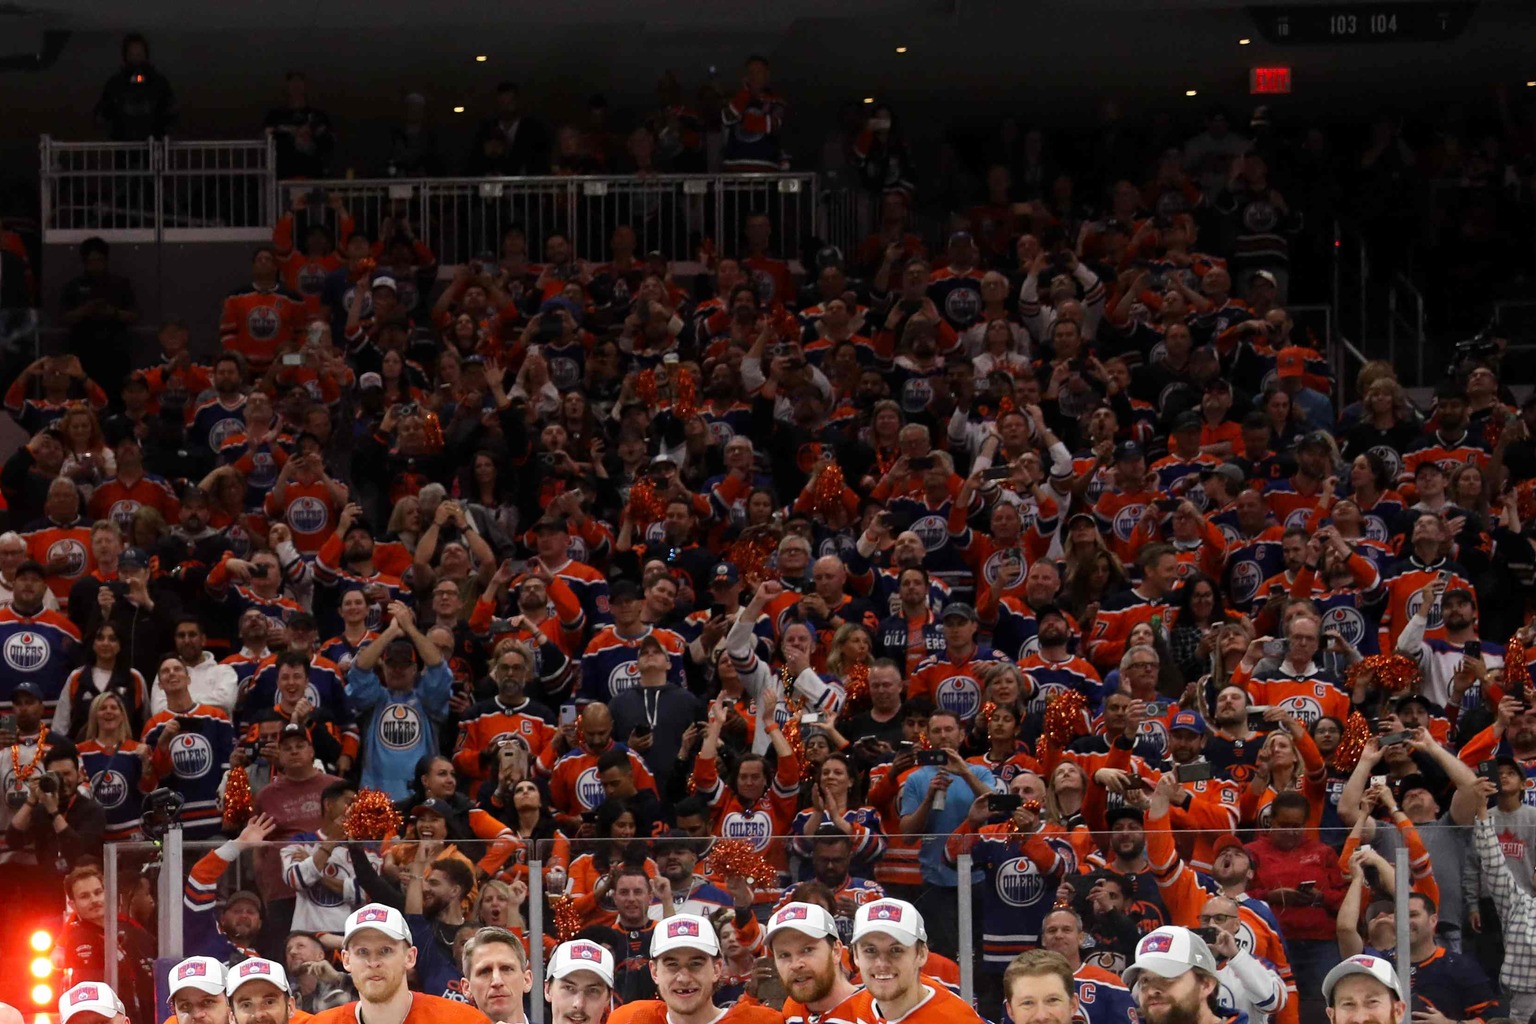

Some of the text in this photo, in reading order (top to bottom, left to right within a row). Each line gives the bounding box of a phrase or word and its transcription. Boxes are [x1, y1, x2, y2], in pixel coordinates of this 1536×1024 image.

[1330, 14, 1398, 35] 103 104
[1255, 67, 1289, 91] EXIT
[11, 645, 44, 661] OILERS
[1315, 684, 1327, 697] C
[941, 693, 977, 710] OILERS
[383, 719, 420, 737] OILERS
[521, 720, 534, 735] C
[171, 750, 209, 768] OILERS
[1001, 765, 1014, 780] C
[729, 821, 765, 839] OILERS
[1003, 874, 1045, 896] OILERS
[855, 891, 866, 905] C
[1079, 983, 1096, 1003] C
